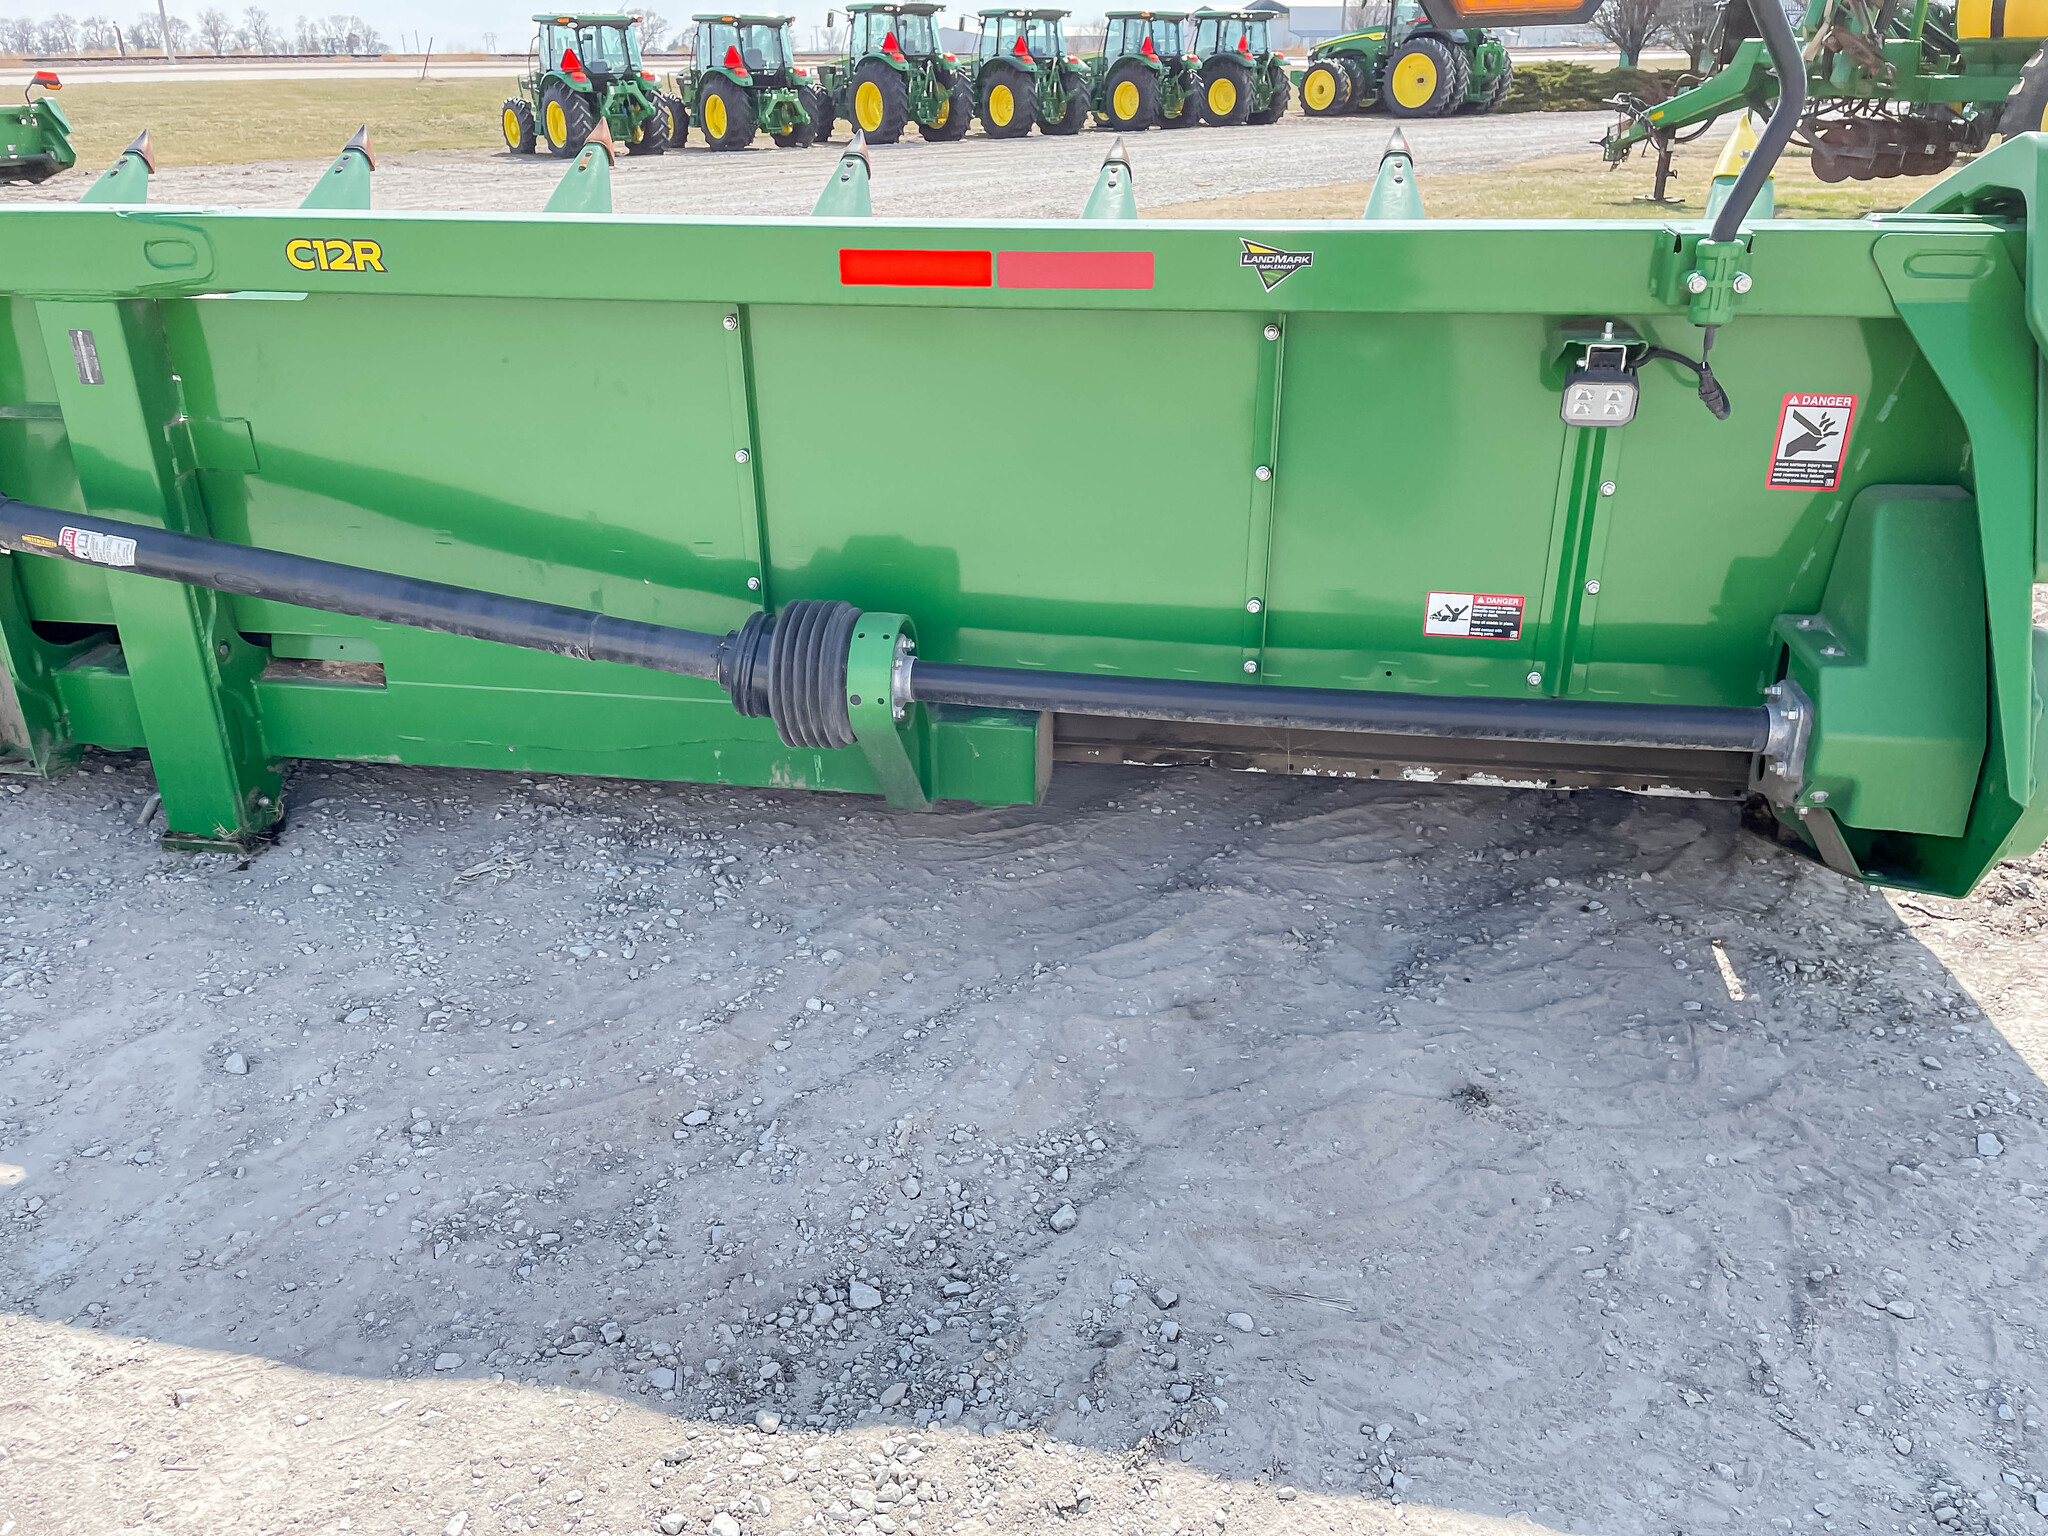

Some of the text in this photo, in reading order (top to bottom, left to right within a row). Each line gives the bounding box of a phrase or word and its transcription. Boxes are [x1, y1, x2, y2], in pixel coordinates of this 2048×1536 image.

[286, 239, 386, 271] C12R
[1802, 396, 1852, 406] DANGER
[1486, 597, 1518, 605] DANGER
